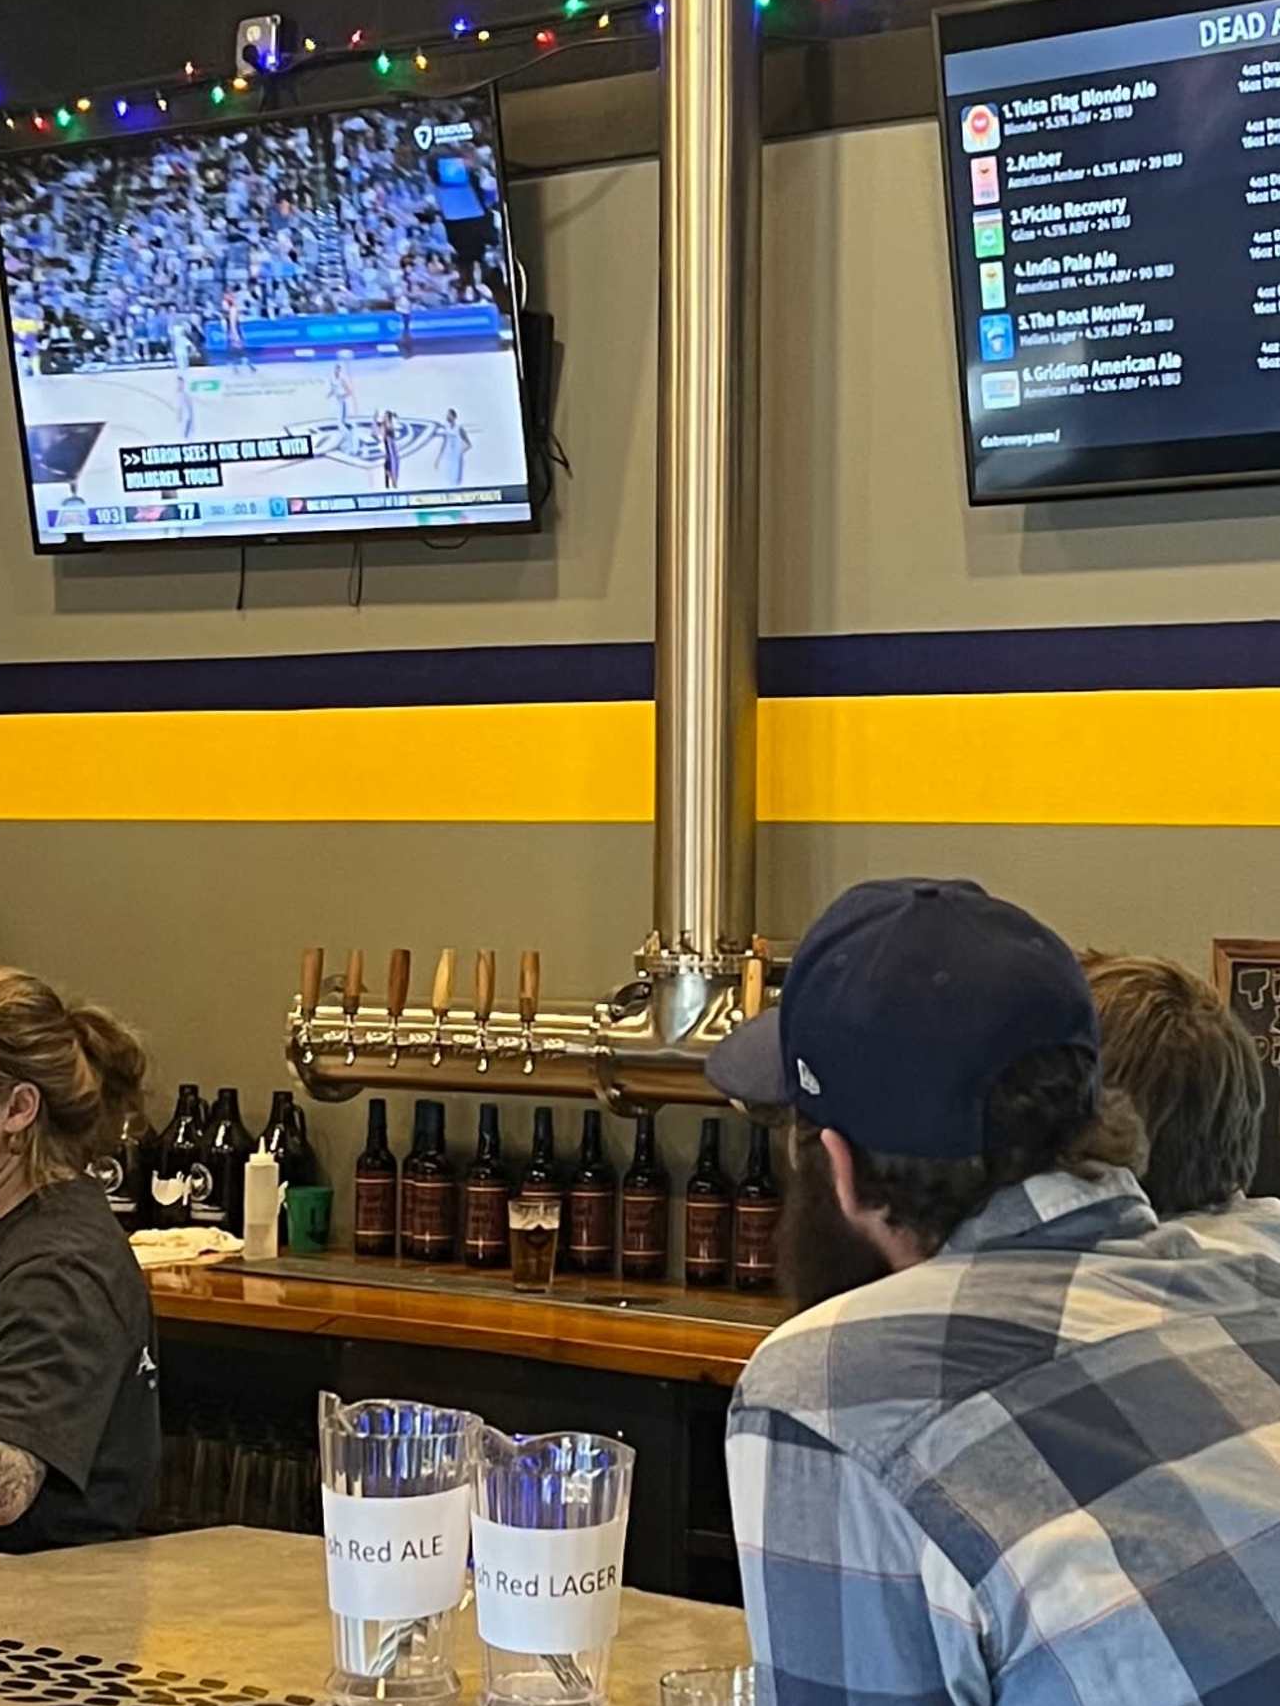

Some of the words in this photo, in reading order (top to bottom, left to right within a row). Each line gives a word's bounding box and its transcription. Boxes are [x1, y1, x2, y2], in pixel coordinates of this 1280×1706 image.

[1200, 12, 1266, 48] DEAD
[1051, 93, 1079, 112] Flag
[1081, 85, 1130, 106] Blonde
[1133, 81, 1156, 100] Ale
[1064, 198, 1127, 218] Recovery
[1063, 254, 1092, 272] Pale
[1095, 250, 1117, 268] Ale
[1057, 308, 1089, 326] Boat
[1091, 302, 1145, 321] Monkey
[1091, 355, 1155, 377] American
[1159, 352, 1182, 369] Ale
[96, 508, 119, 526] 103
[178, 504, 195, 520] 77
[349, 1539, 391, 1563] Red
[401, 1535, 443, 1562] ALE
[497, 1571, 538, 1597] Red
[550, 1564, 616, 1597] LAGER
